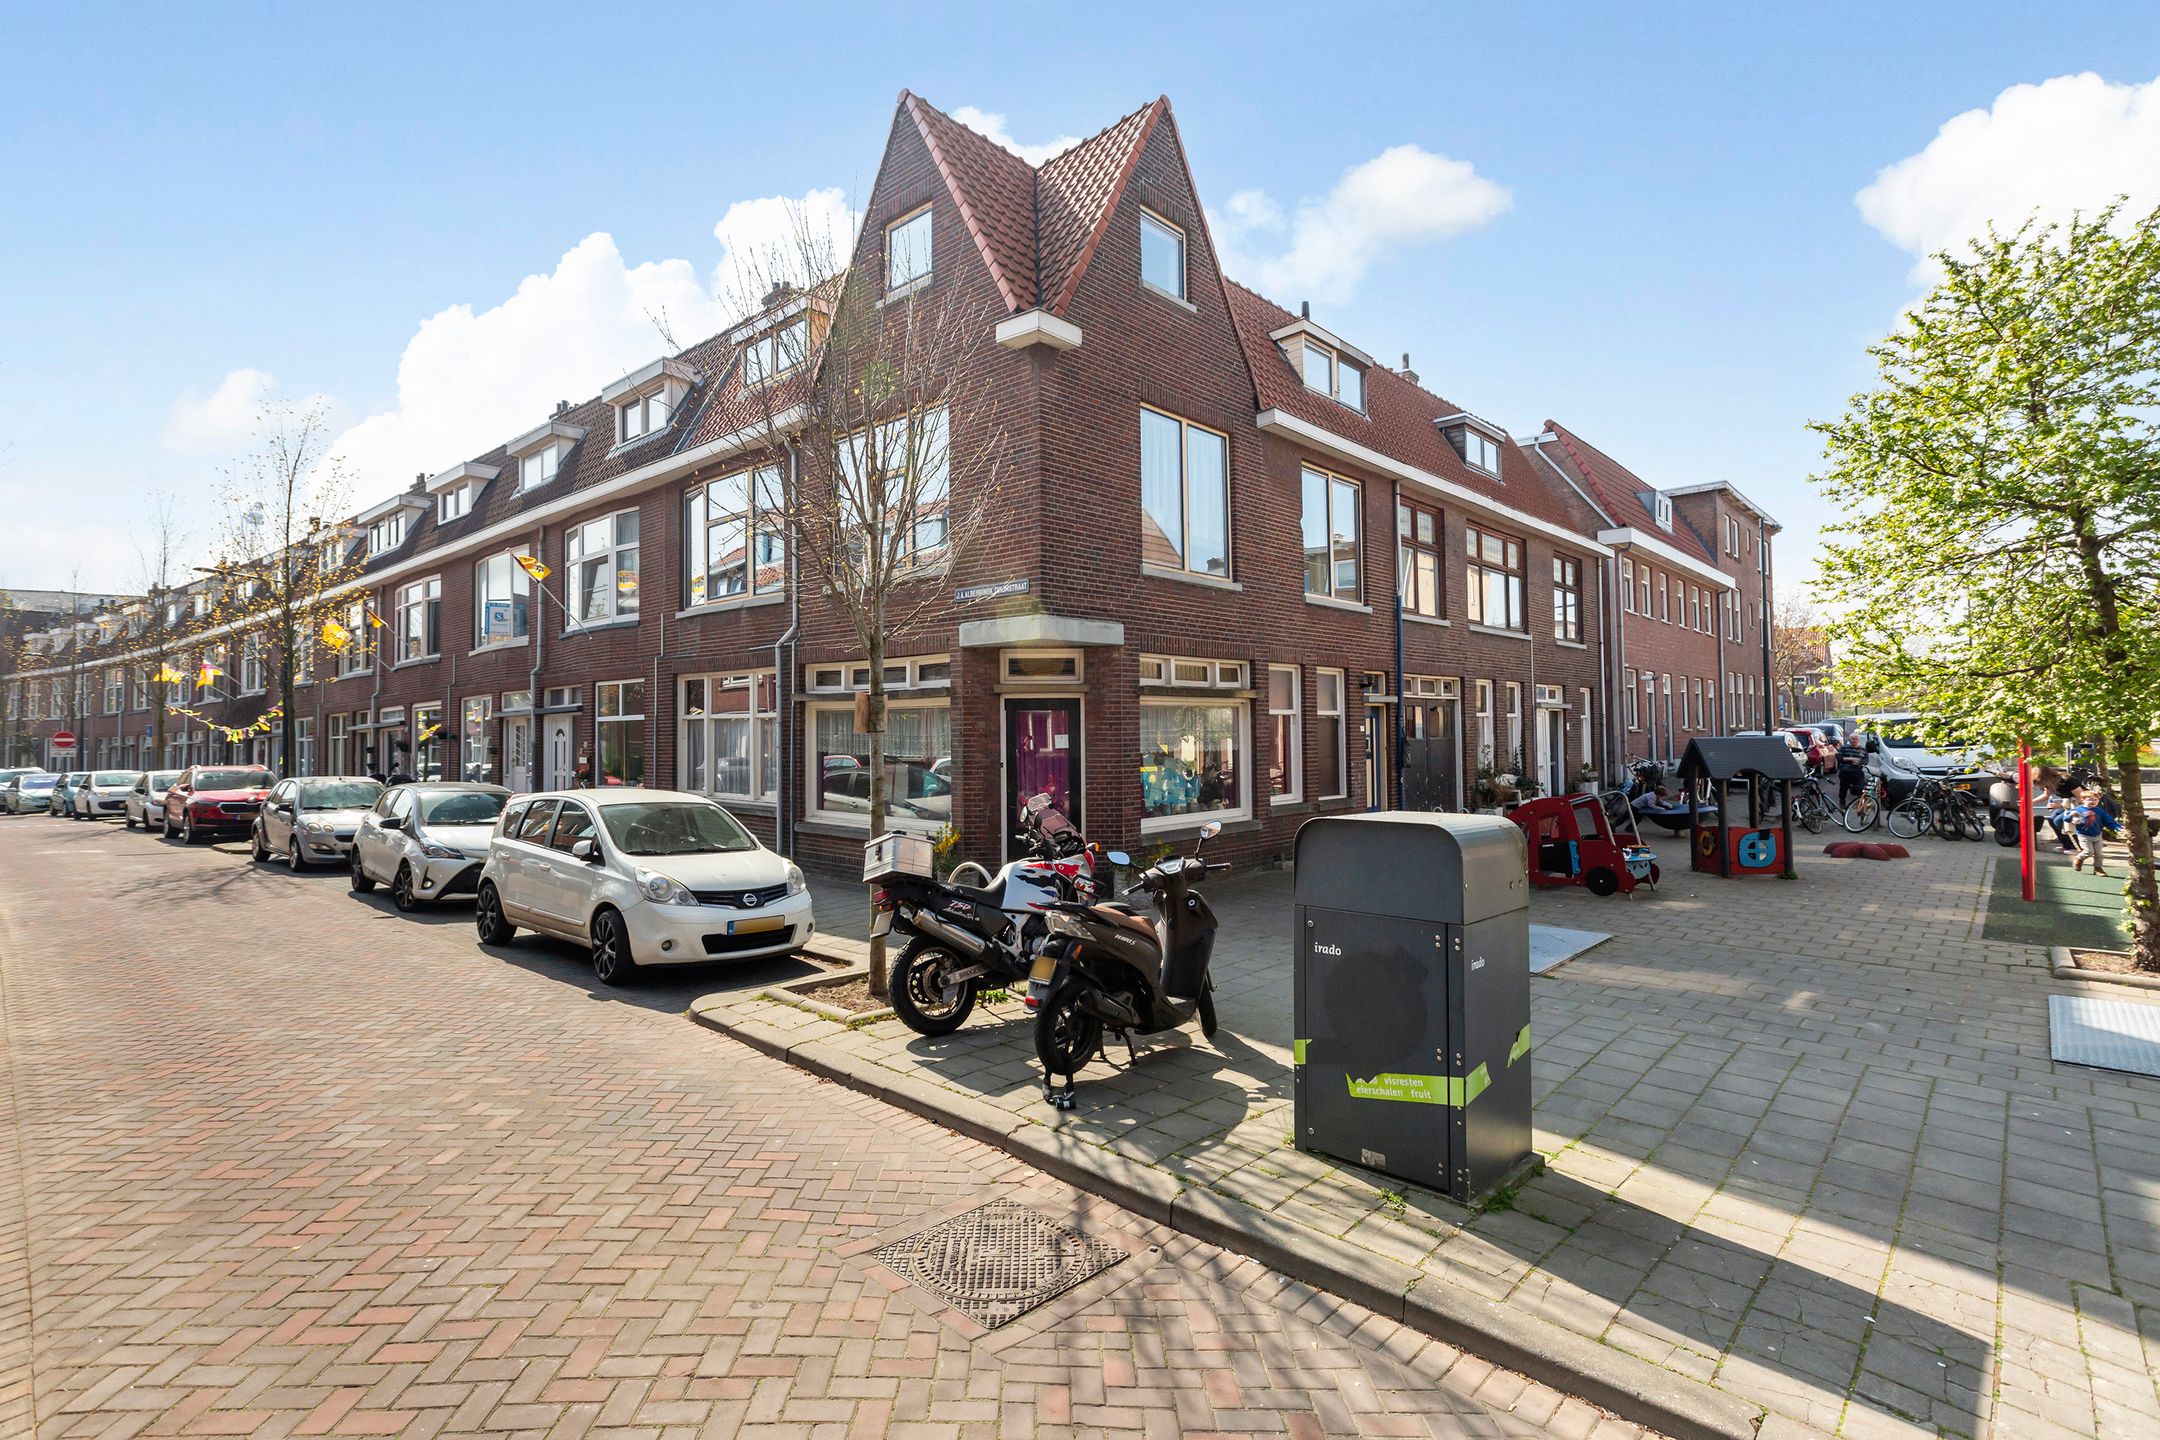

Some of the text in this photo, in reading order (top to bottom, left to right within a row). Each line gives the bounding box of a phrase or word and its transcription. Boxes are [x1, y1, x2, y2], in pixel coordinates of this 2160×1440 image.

[1314, 941, 1342, 956] irado
[1384, 1076, 1424, 1087] visresten
[1356, 1086, 1432, 1099] eierschalen fruit
